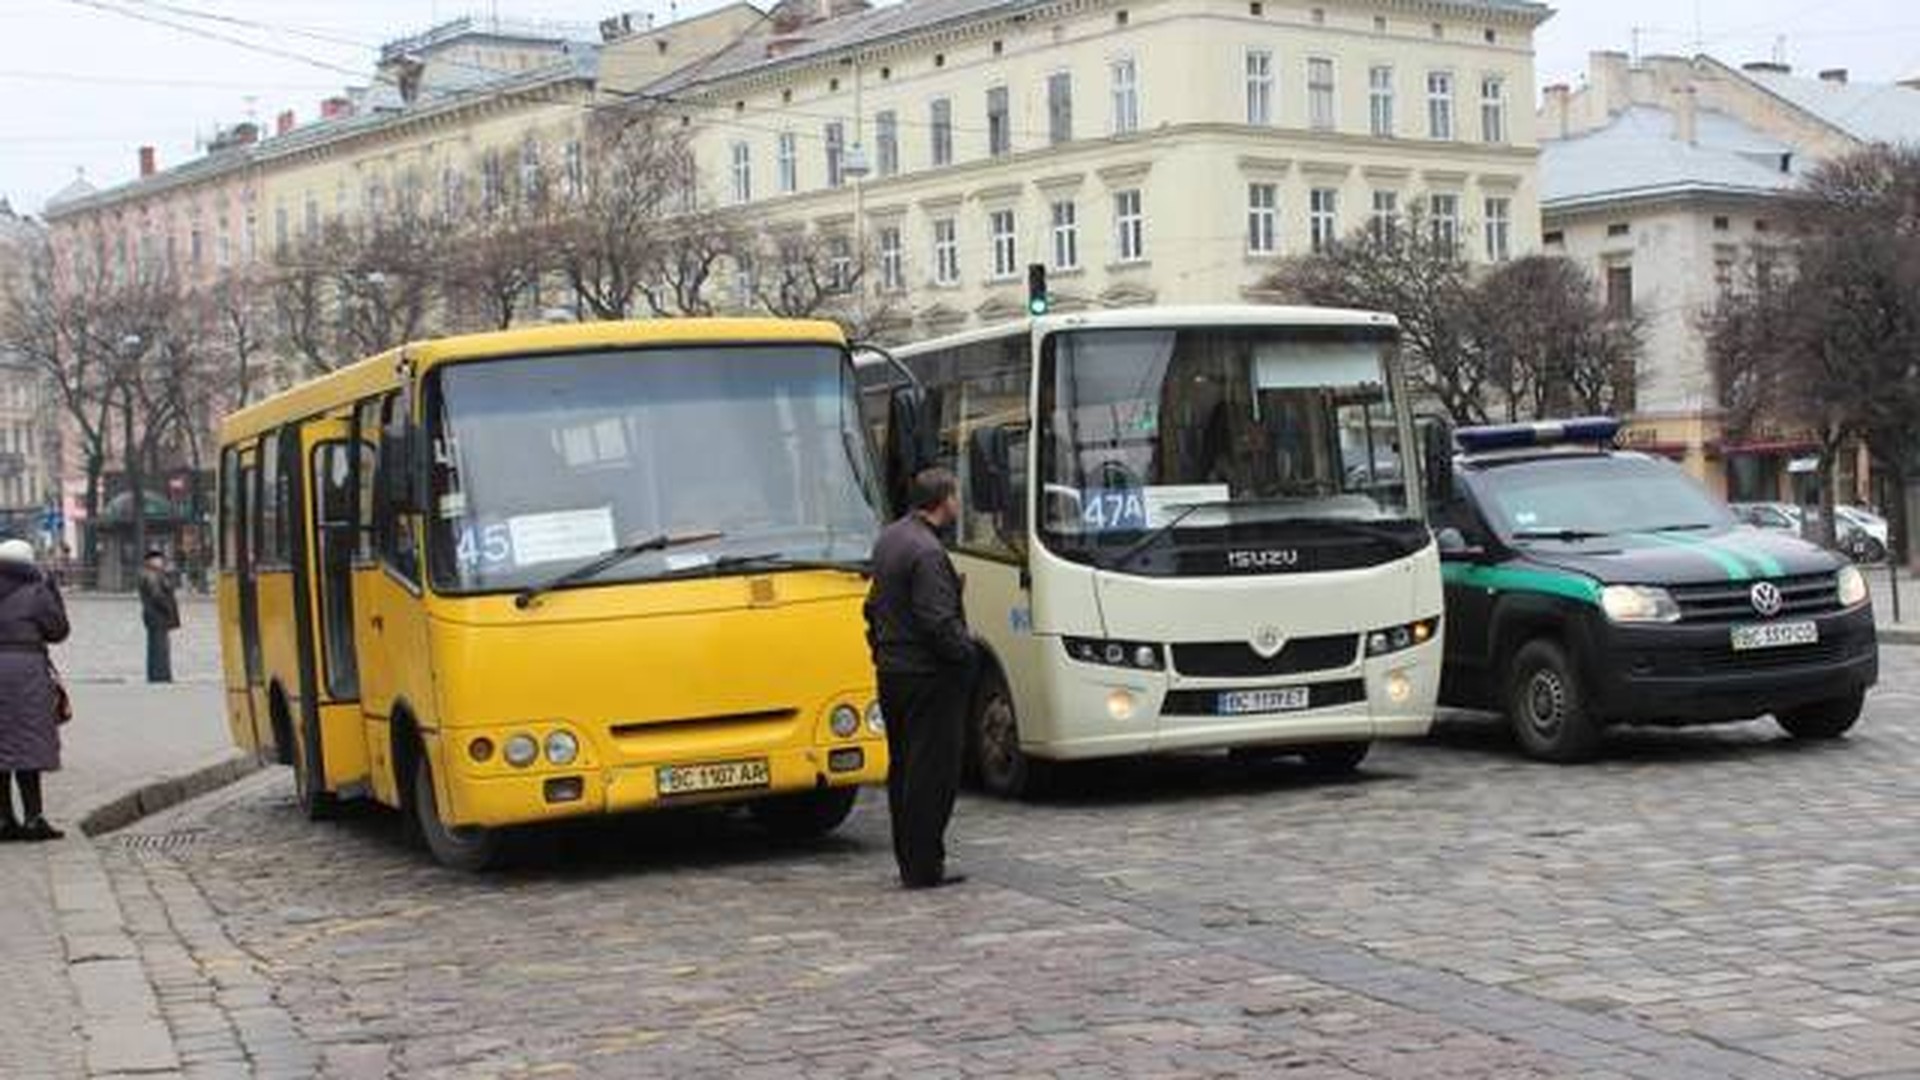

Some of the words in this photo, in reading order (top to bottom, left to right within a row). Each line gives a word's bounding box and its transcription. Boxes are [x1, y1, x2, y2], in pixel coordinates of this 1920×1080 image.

[1084, 494, 1142, 527] 47A
[456, 524, 509, 564] 45
[1229, 550, 1298, 567] ISUZU
